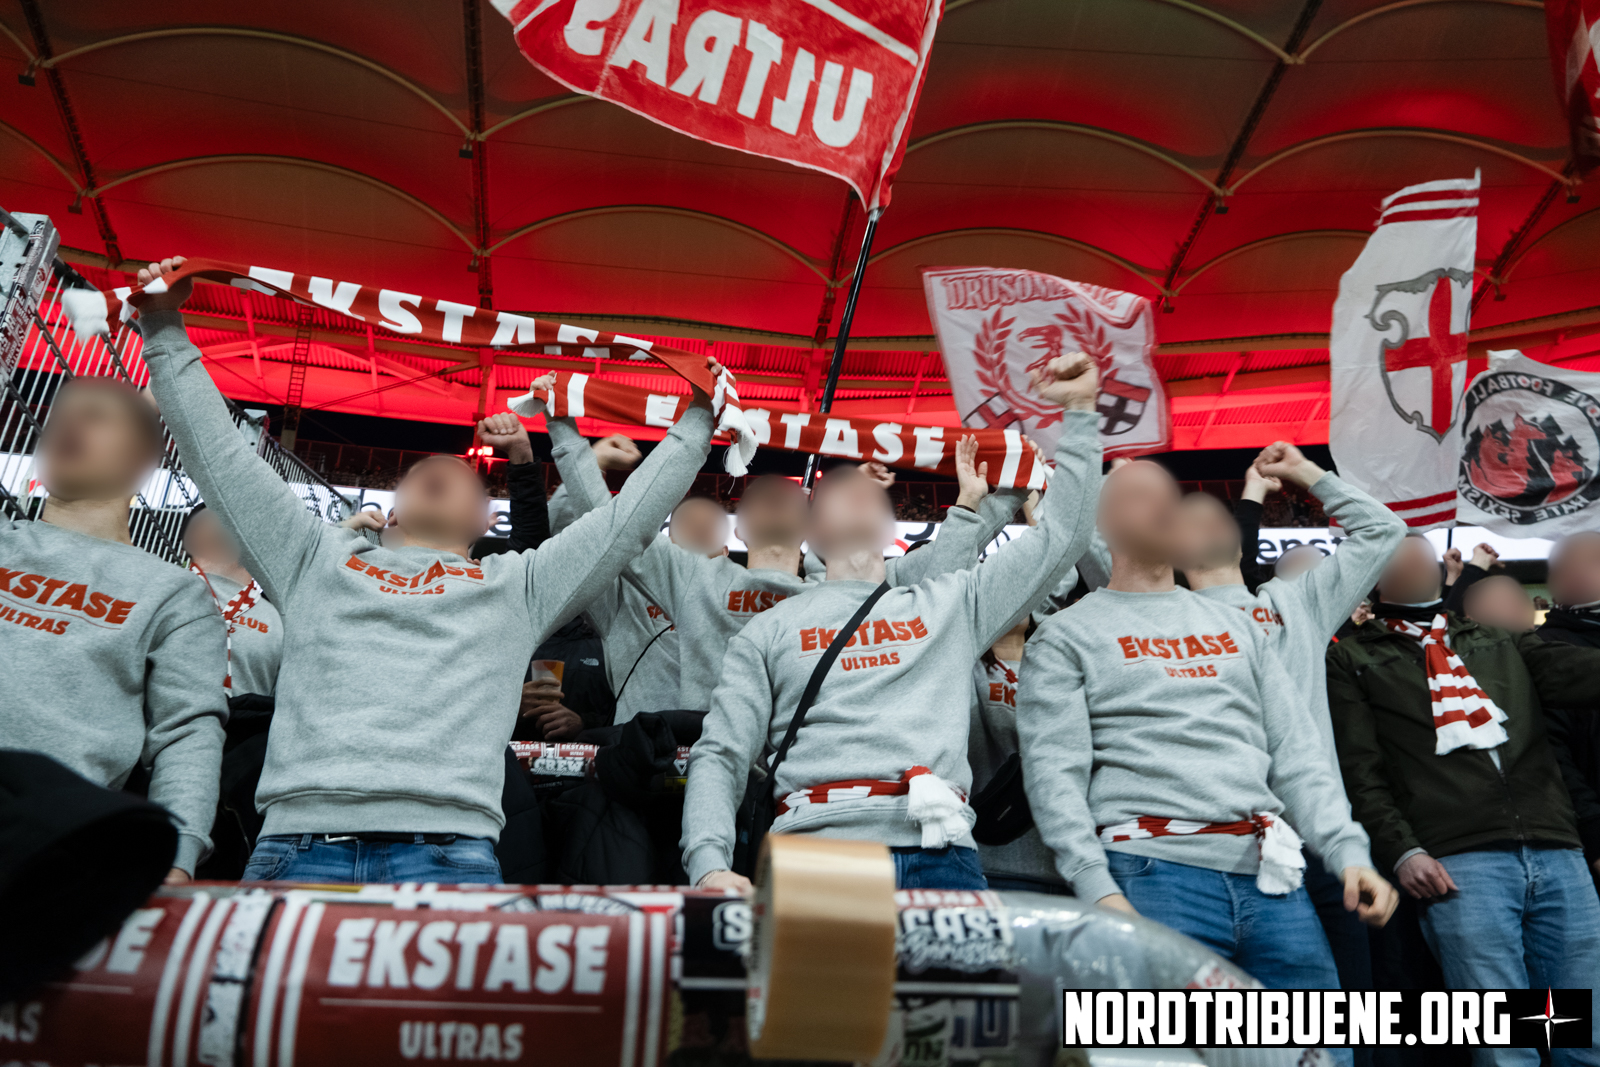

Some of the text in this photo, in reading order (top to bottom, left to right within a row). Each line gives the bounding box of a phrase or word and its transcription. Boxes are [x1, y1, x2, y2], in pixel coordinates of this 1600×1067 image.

[345, 554, 485, 589] EKSTASE
[379, 584, 445, 595] ULAS
[0, 602, 71, 635] ULTRAS
[1117, 631, 1239, 660] EKSTASE
[841, 652, 901, 671] ULTRAS
[1164, 664, 1218, 678] ULTRAS
[327, 918, 610, 994] EKSTASE
[398, 1020, 525, 1062] ULTRAS
